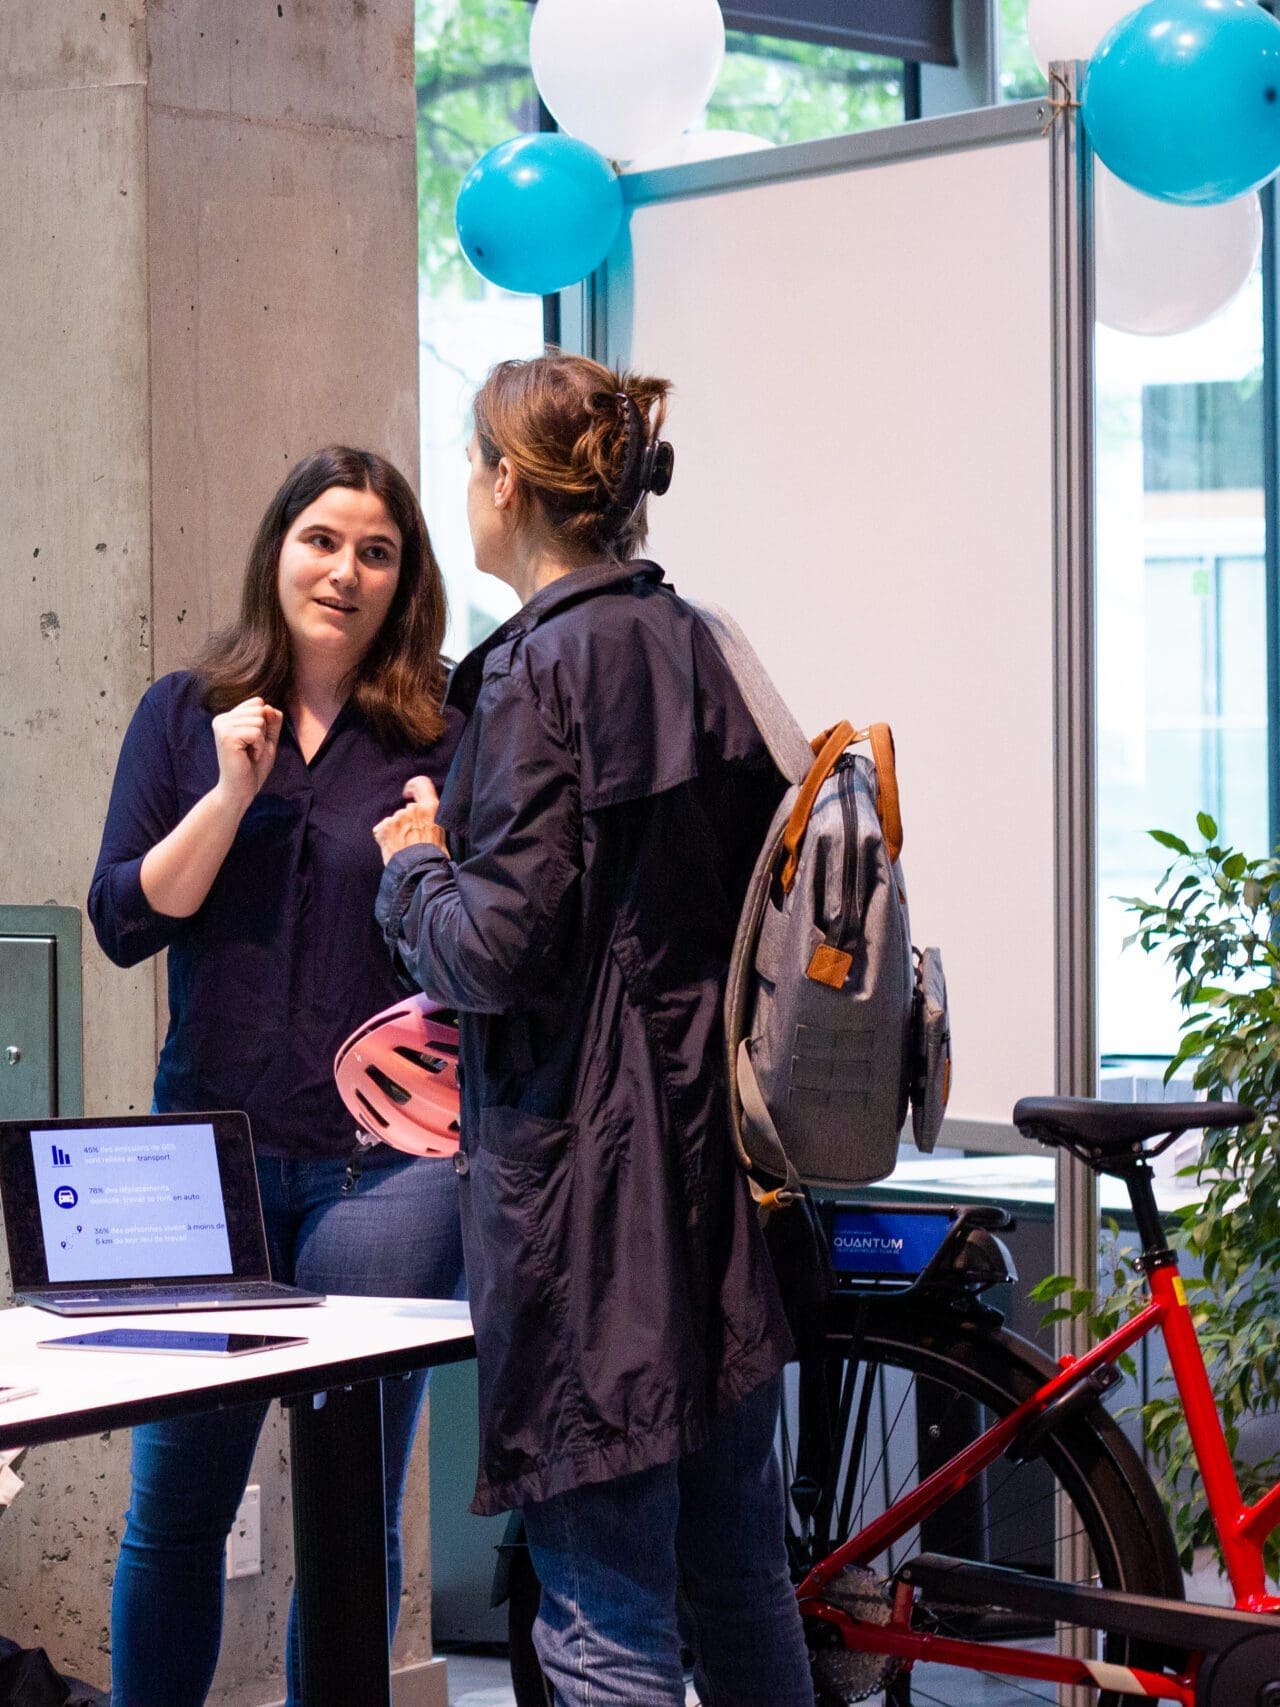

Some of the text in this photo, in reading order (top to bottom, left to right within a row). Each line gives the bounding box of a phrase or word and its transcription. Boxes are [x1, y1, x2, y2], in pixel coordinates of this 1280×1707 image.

[137, 1154, 171, 1163] transport
[184, 1193, 200, 1202] auto
[187, 1223, 192, 1231] à
[193, 1222, 215, 1231] moins
[216, 1221, 225, 1230] de
[833, 1237, 904, 1249] QUANTUM
